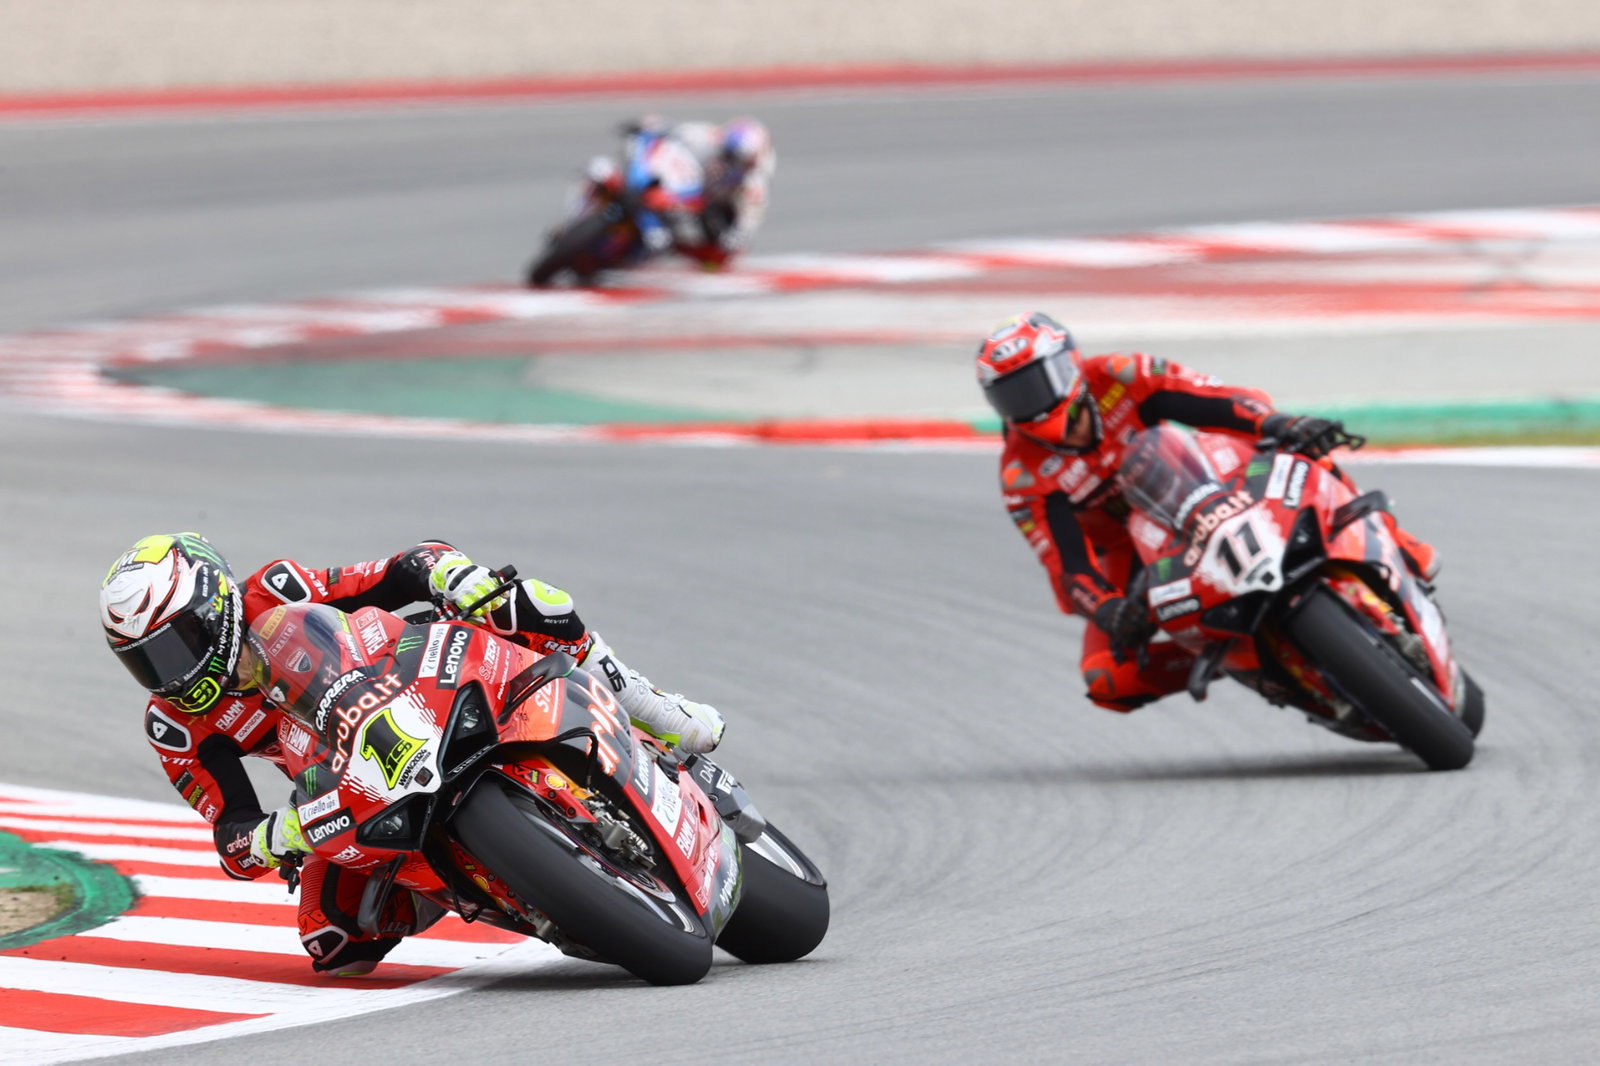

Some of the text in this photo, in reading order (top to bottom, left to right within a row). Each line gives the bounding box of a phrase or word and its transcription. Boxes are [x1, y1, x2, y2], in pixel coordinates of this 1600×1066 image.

[1218, 522, 1261, 578] 11
[183, 645, 215, 682] Motostorm.it
[440, 630, 468, 684] Lenovo
[214, 700, 246, 730] FIAMM
[316, 669, 365, 731] CARRERA
[331, 672, 402, 774] aruba.it
[360, 707, 430, 791] 1
[307, 815, 350, 843] Lenovo
